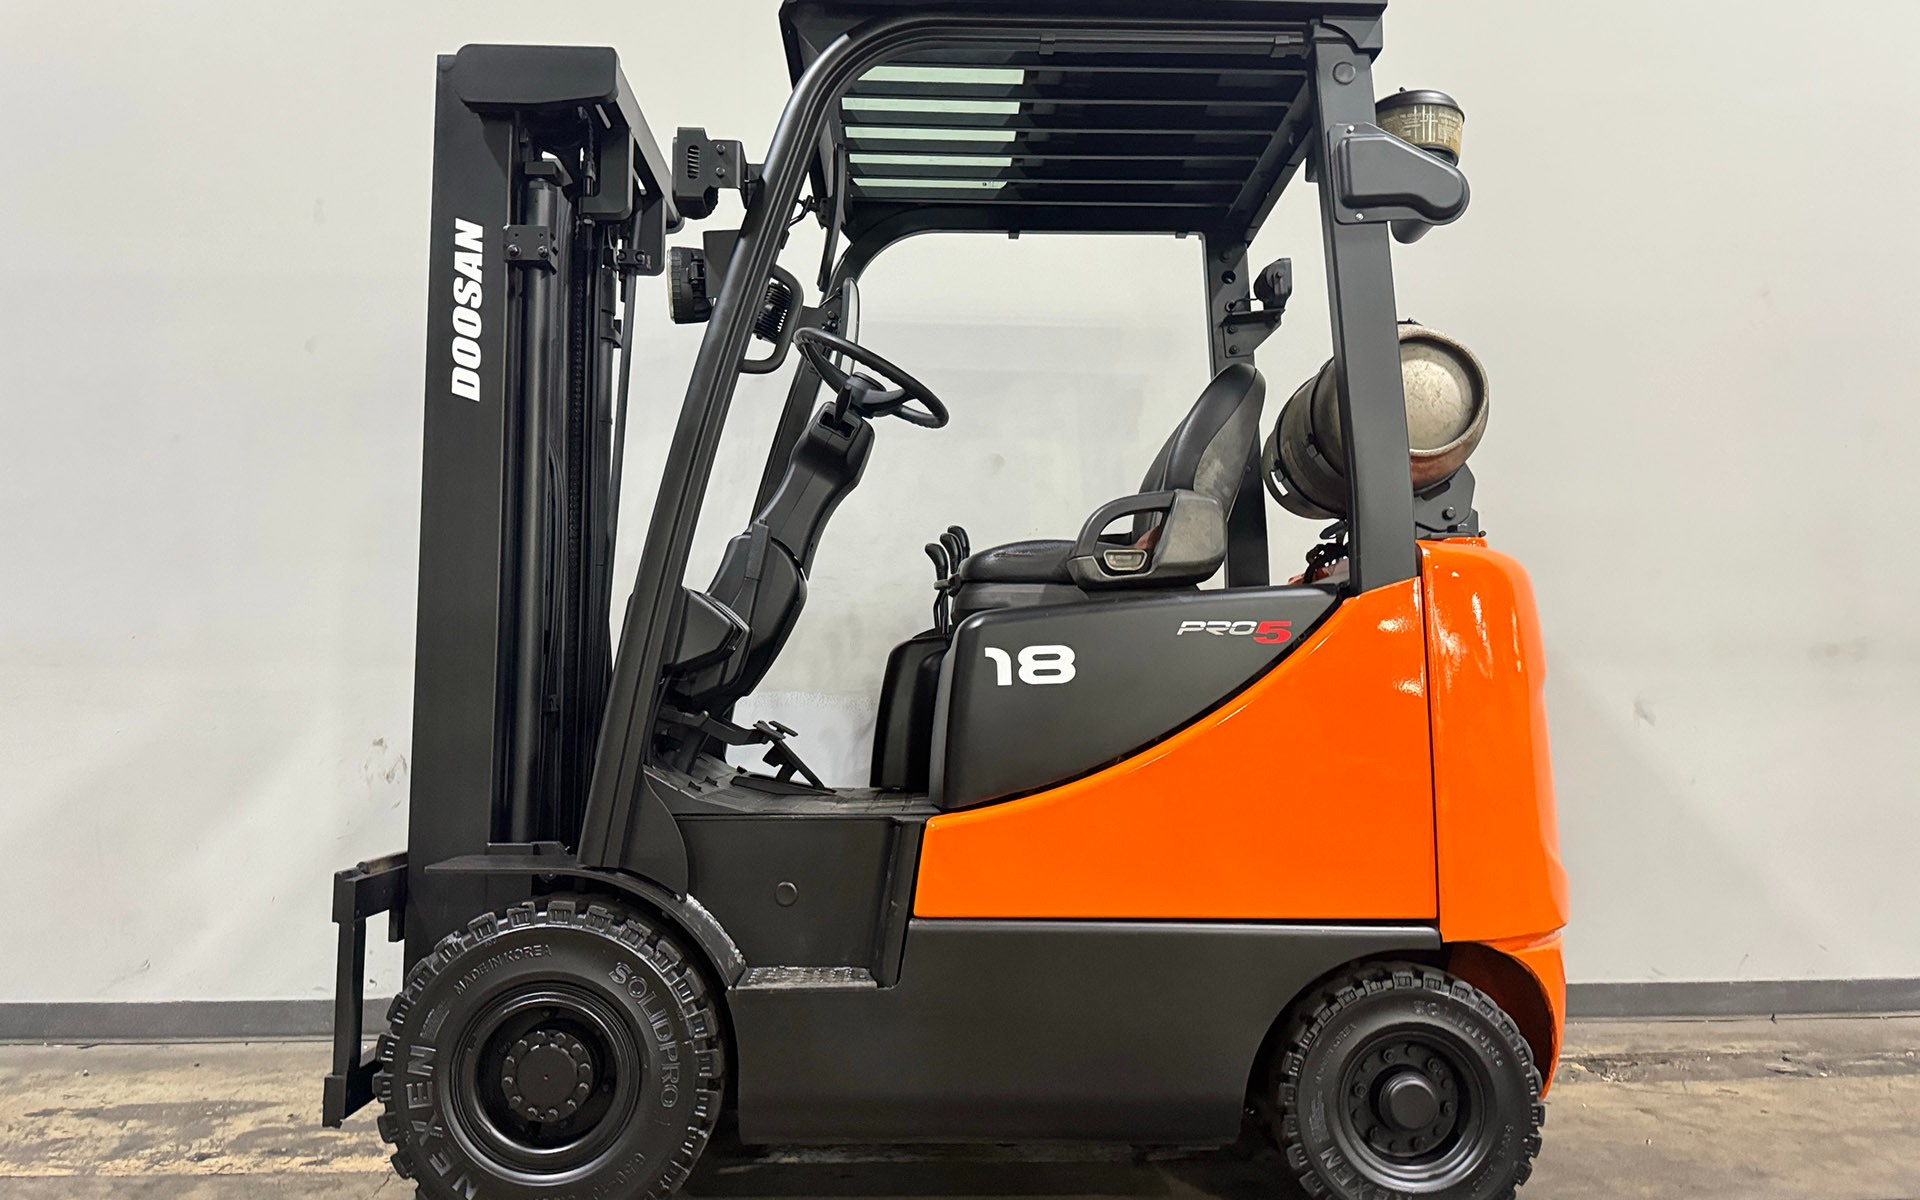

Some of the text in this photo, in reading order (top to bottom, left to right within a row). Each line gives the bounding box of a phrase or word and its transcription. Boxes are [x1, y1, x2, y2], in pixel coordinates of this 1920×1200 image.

[452, 218, 484, 402] DOOSAN
[984, 644, 1077, 686] 18
[453, 944, 552, 994] MADE IN KOREA
[608, 961, 682, 1108] SOLIDPRO
[406, 1044, 480, 1200] NEXEN
